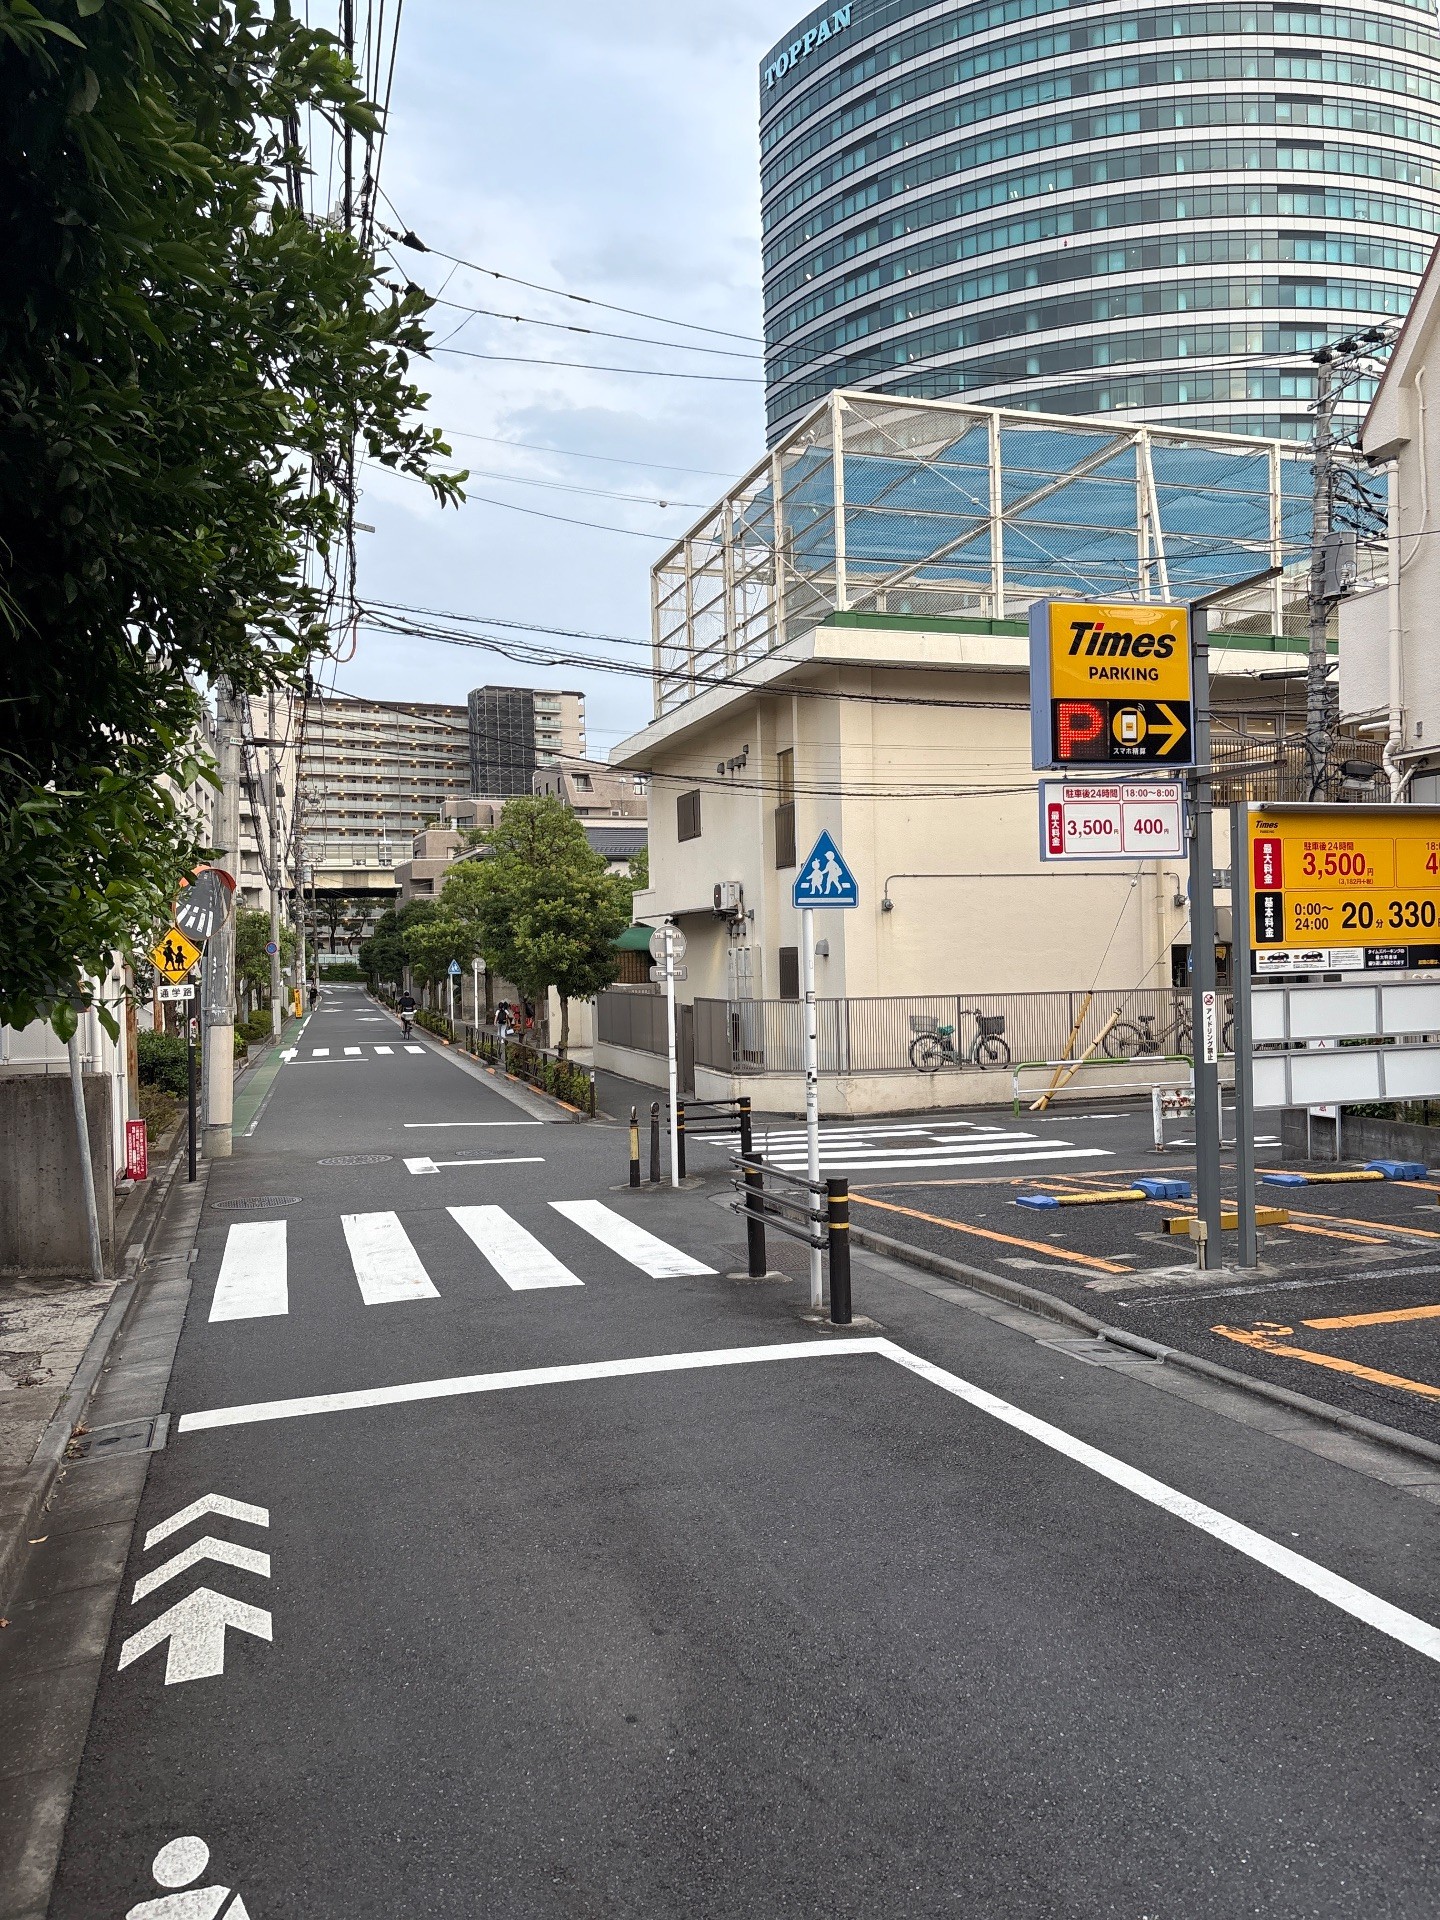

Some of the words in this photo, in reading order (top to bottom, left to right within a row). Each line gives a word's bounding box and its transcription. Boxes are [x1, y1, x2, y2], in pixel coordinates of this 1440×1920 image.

[764, 3, 853, 90] TOPPAN
[1068, 621, 1177, 659] Times
[1088, 666, 1159, 681] PARKING
[1058, 702, 1103, 758] P
[1113, 747, 1147, 755] スマホ精算
[1065, 788, 1118, 799] 駐車後24時間
[1051, 811, 1061, 846] 最大料金
[1255, 820, 1279, 829] Times
[1263, 843, 1273, 885] 最大料金
[1264, 896, 1274, 938] 基本料金
[1294, 917, 1329, 930] 24:00
[160, 987, 193, 998] 通学路
[1206, 1008, 1214, 1061] アイドリング禁止
